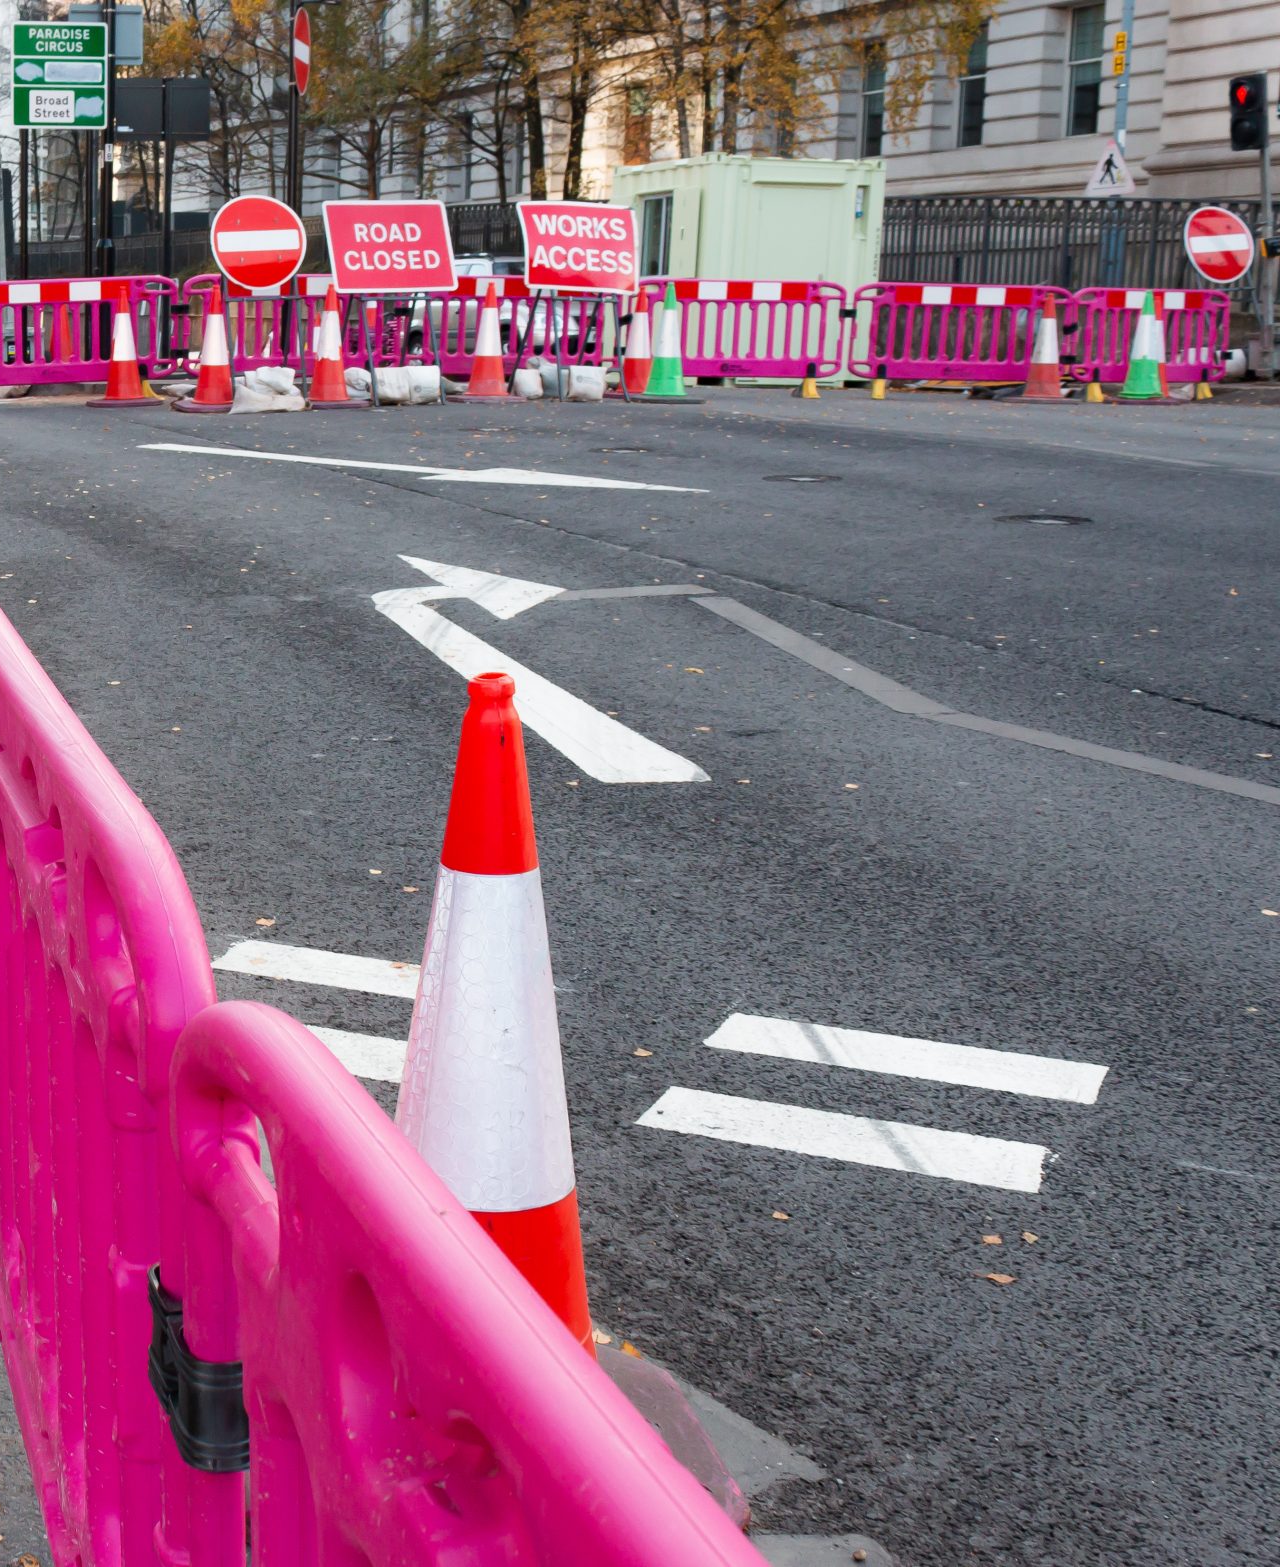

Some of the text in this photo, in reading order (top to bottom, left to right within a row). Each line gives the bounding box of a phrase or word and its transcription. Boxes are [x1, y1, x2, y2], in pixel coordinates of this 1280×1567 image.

[28, 28, 90, 40] PARADISE
[35, 41, 83, 52] CIRCUS
[35, 95, 69, 106] Broad
[34, 108, 70, 118] Street
[353, 222, 421, 243] ROAD
[531, 213, 627, 241] WORKS
[343, 249, 441, 271] CLOSED
[532, 244, 633, 275] ACCESS
